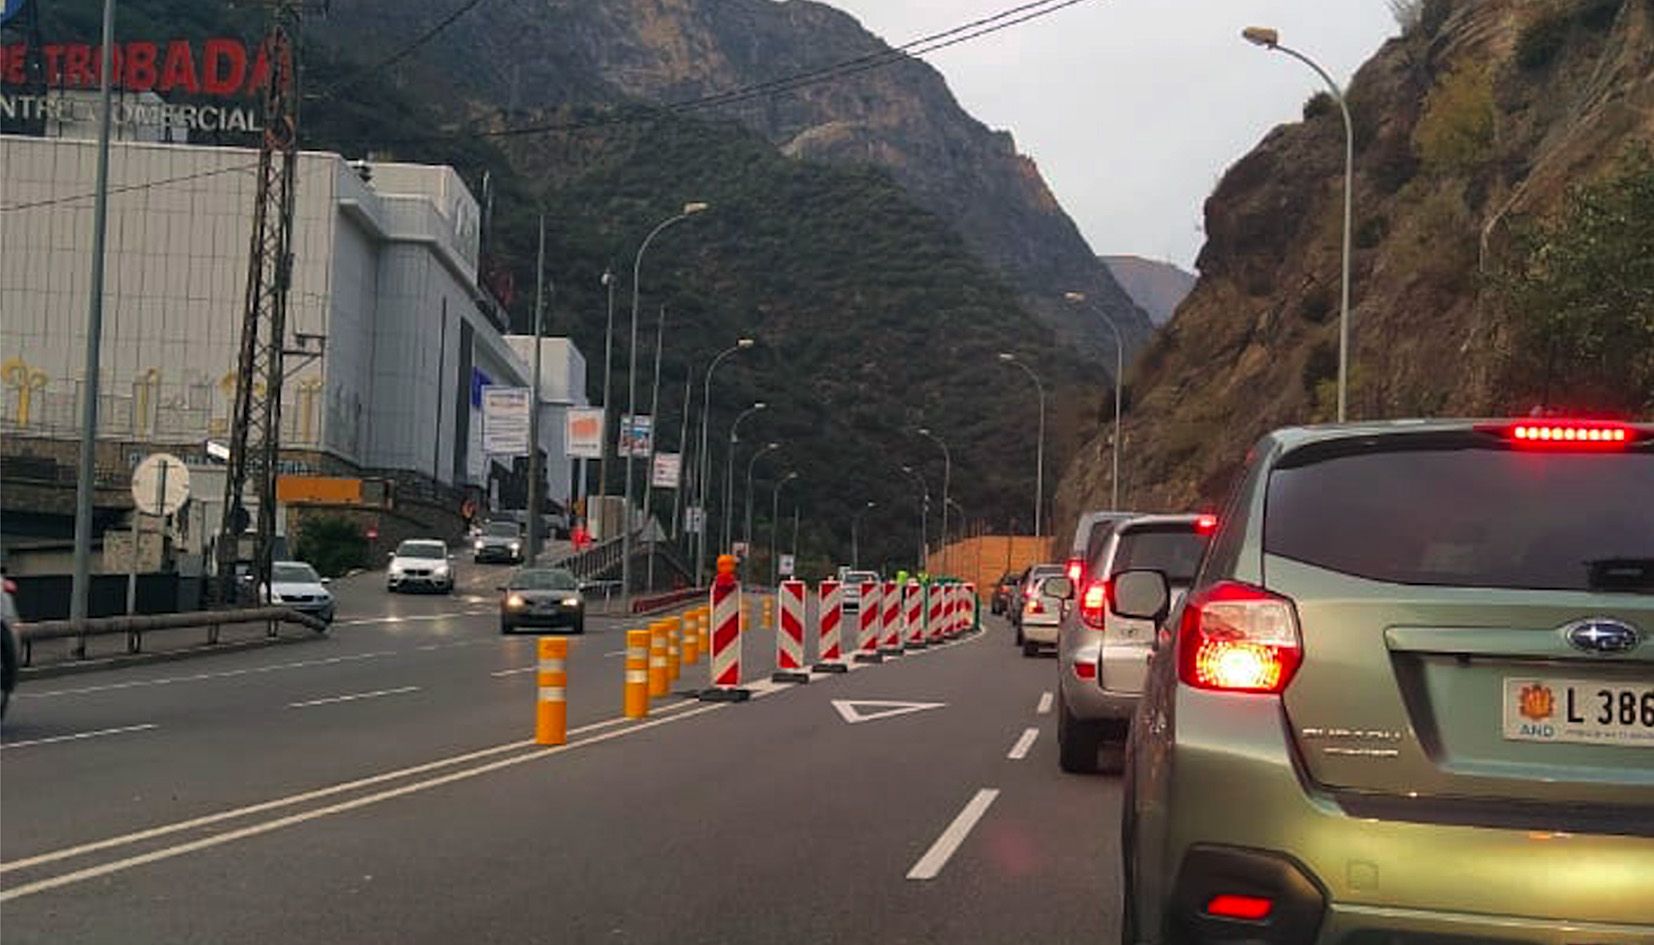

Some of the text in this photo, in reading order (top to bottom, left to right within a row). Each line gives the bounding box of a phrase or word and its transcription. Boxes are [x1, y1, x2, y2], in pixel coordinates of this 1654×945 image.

[1567, 687, 1654, 727] L 386
[1520, 724, 1554, 737] AND
